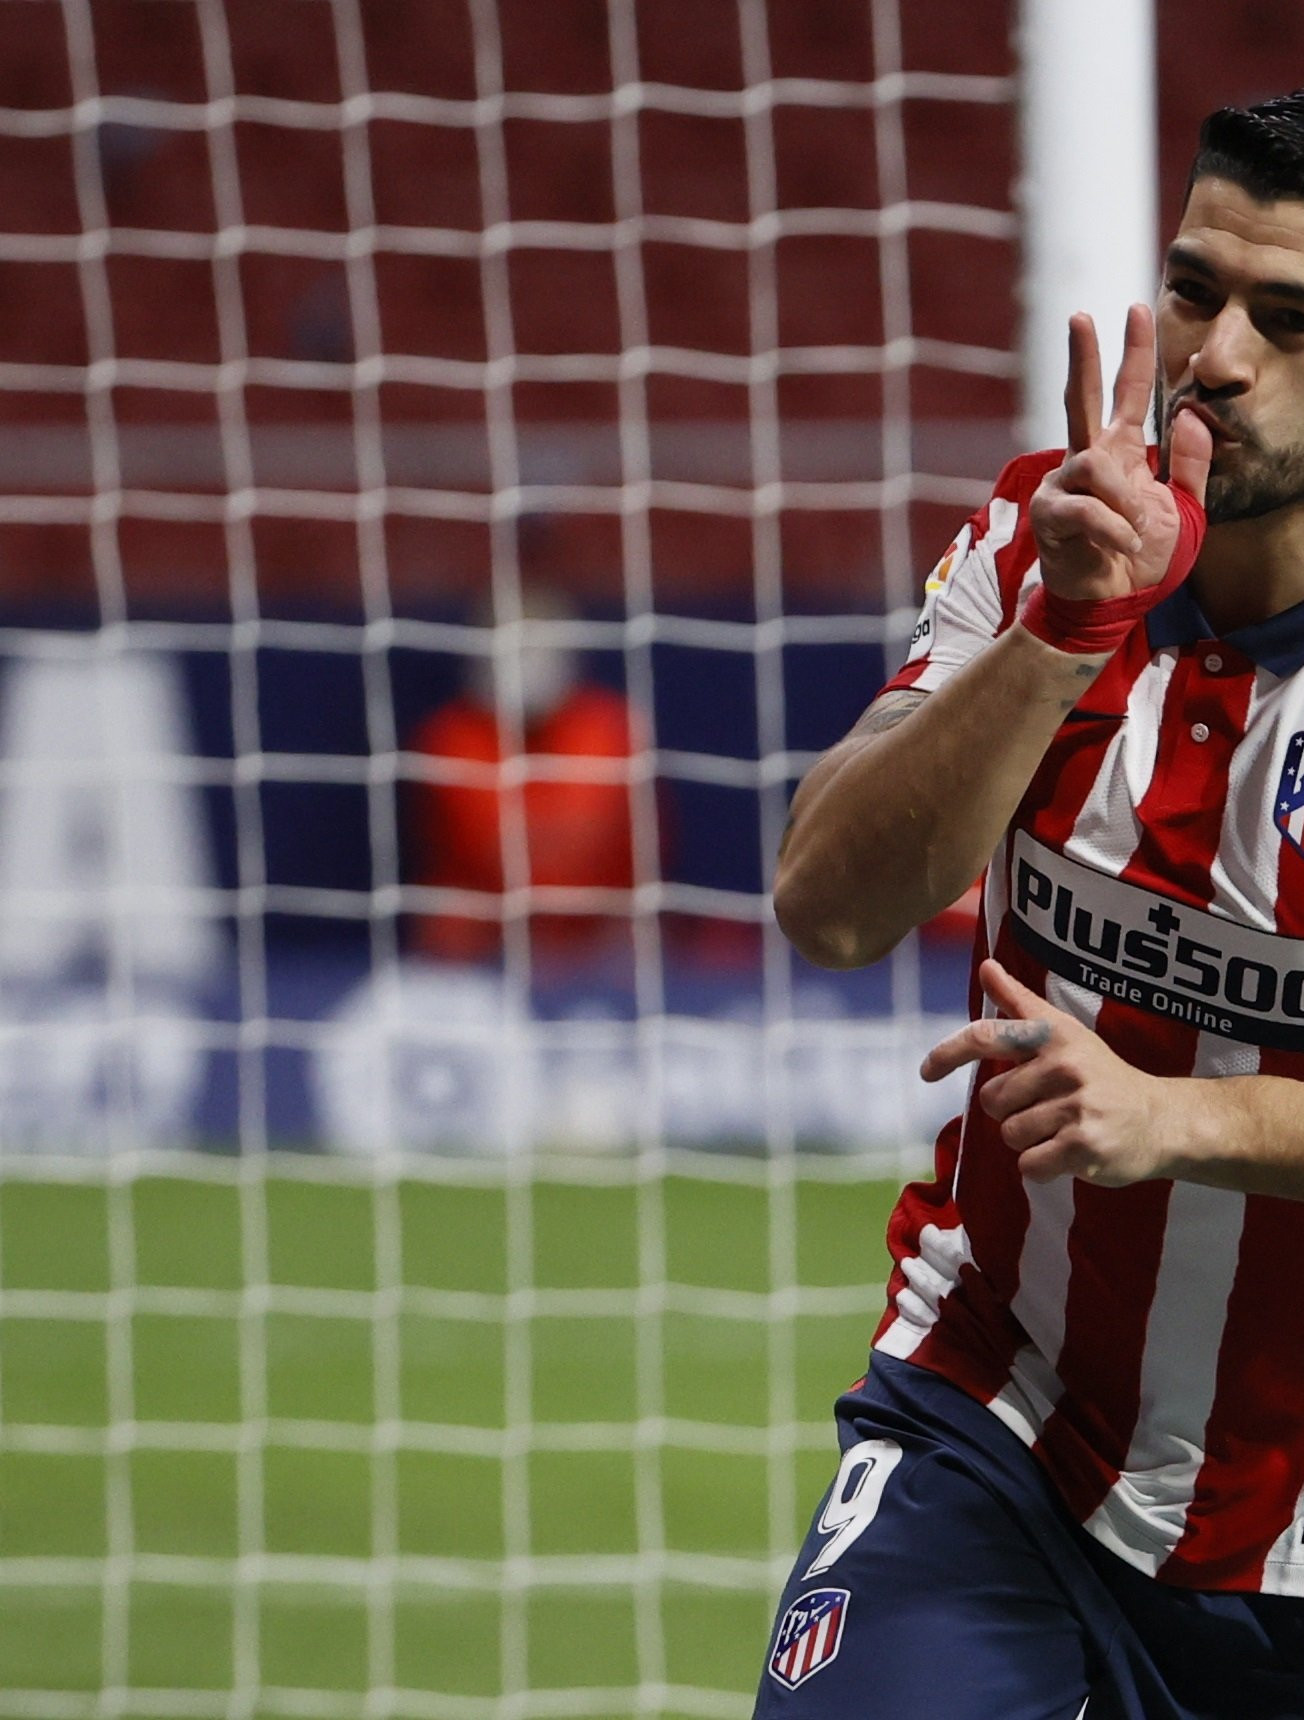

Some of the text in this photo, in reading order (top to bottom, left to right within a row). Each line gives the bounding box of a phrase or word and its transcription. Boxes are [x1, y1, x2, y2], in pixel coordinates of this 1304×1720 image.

[1078, 963, 1234, 1034] Trade Online
[800, 1438, 903, 1581] 9
